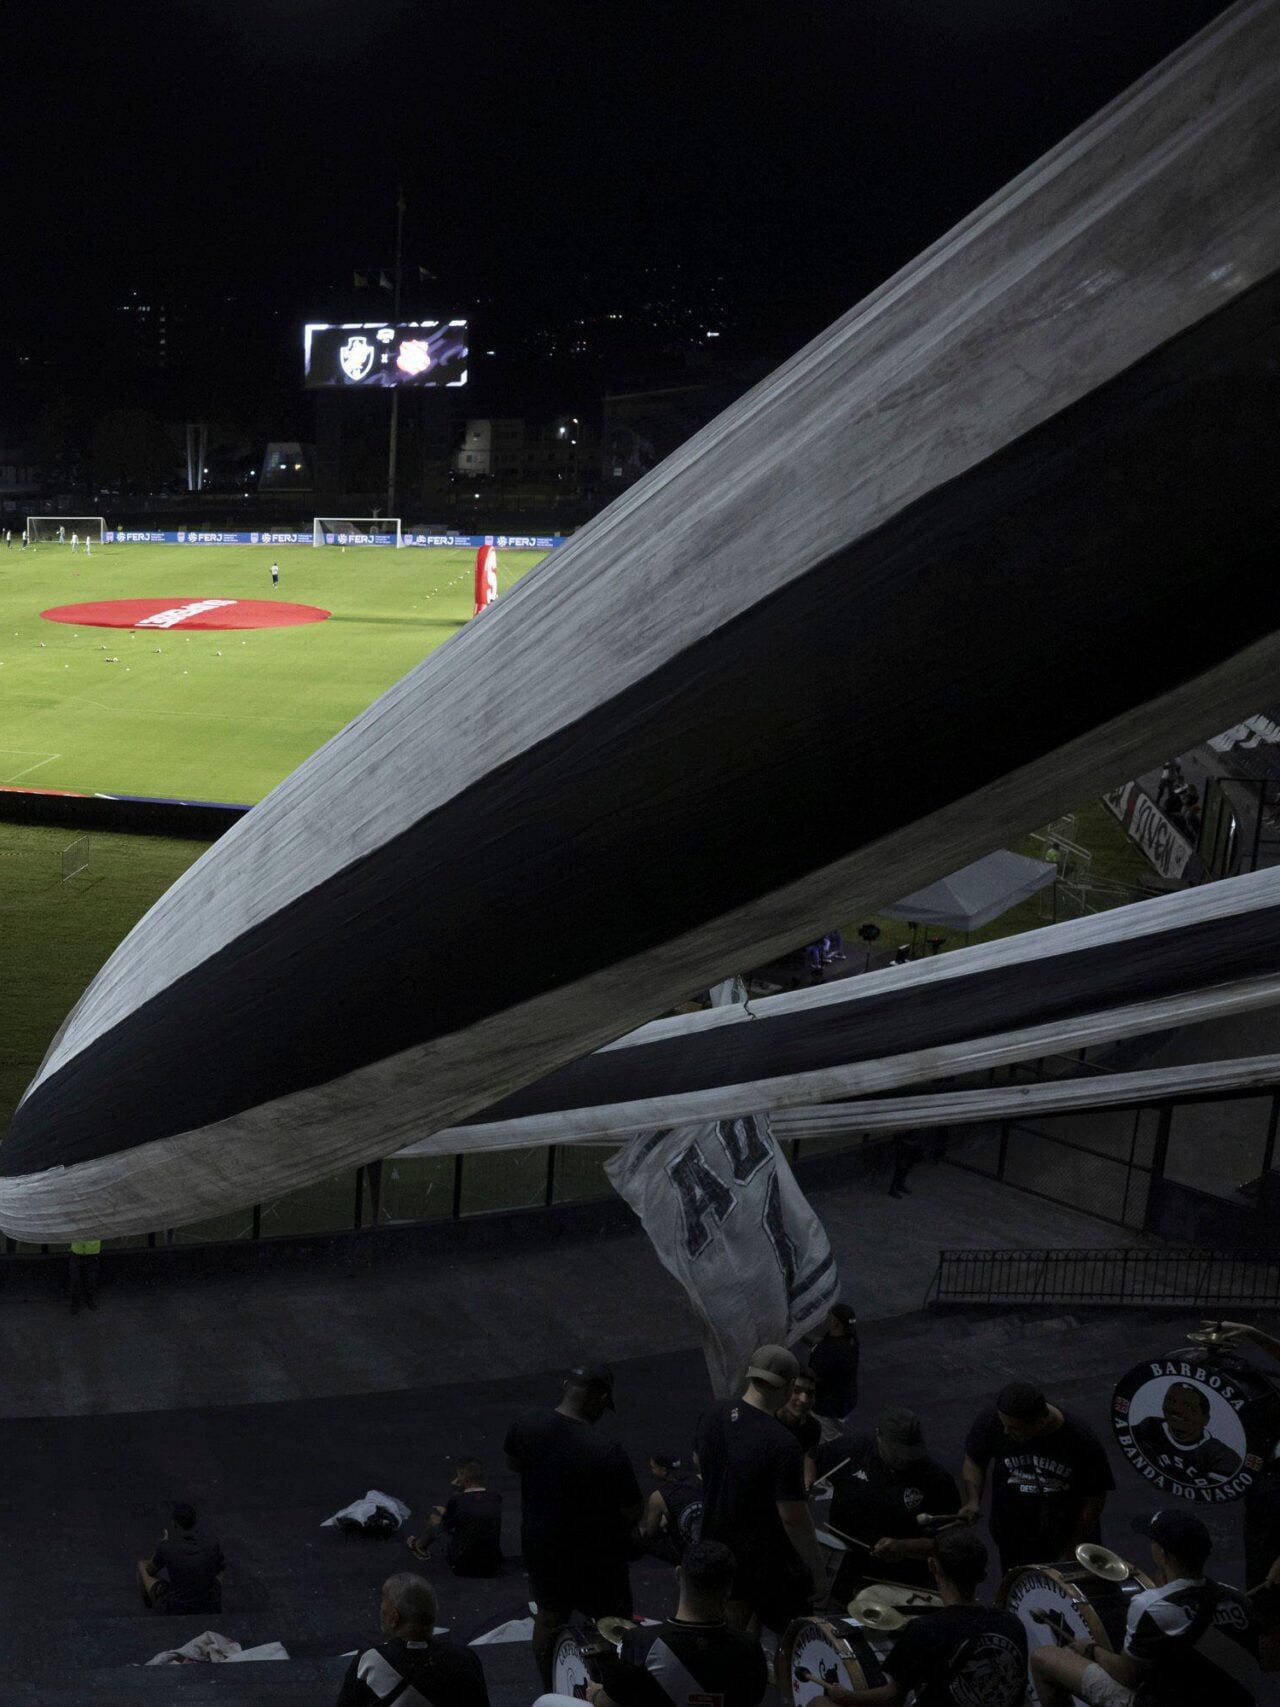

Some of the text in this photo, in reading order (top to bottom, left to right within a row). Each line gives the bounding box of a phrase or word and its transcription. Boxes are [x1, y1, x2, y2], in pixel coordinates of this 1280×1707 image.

[126, 532, 150, 541] FERJ
[198, 533, 222, 542] FERJ
[272, 534, 298, 542] FERJ
[348, 535, 375, 544] FERJ
[427, 536, 454, 545] FERJ
[508, 537, 536, 547] FERJ
[1150, 1362, 1245, 1412] BARBOSA
[1114, 1418, 1253, 1502] A BANDA DO VASCO
